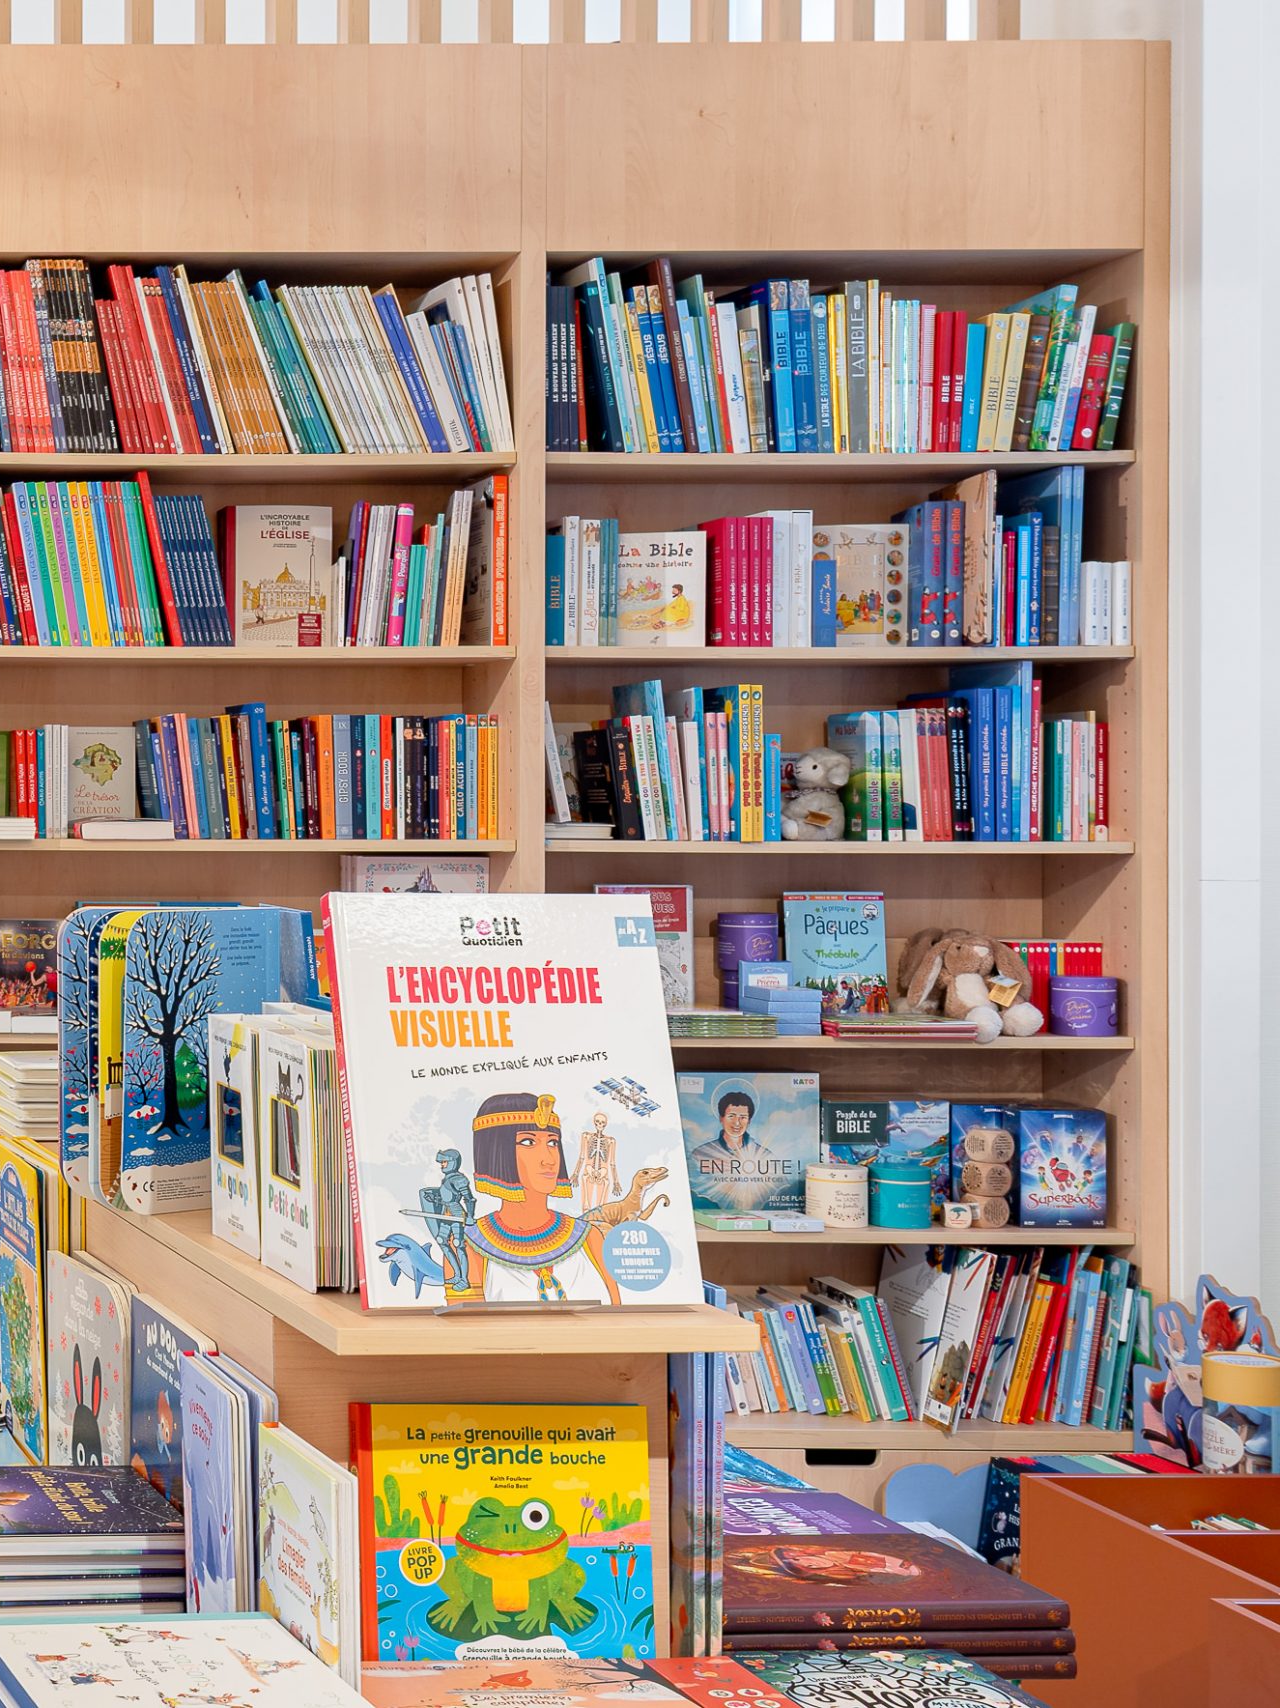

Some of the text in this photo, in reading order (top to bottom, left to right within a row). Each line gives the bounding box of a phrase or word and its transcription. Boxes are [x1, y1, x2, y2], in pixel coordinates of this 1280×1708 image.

[643, 333, 656, 364] JÉSUS
[656, 333, 669, 364] JÉSUS
[778, 331, 788, 369] BIBLE
[797, 331, 809, 374] BIBLE
[851, 312, 865, 378] LA BIBLE
[941, 375, 951, 402] BIBLE
[954, 374, 963, 402] BIBLE
[987, 376, 1001, 412] BIBLE
[1005, 376, 1019, 412] BIBLE
[261, 528, 310, 540] L'ÉGLISE
[931, 508, 941, 537] Bible
[950, 508, 960, 536] Bible
[619, 543, 694, 557] La Bible
[550, 575, 561, 609] BIBLE
[982, 752, 990, 773] BIBLE
[338, 751, 349, 803] GIPSY BOOK
[73, 805, 121, 815] CRÉATION
[871, 780, 879, 819] Ma Bible
[891, 780, 899, 819] Ma Bible
[459, 916, 522, 936] Petit
[804, 913, 869, 942] Pâques
[462, 936, 523, 947] Quotidien
[815, 949, 860, 960] Théobule
[386, 960, 603, 1004] L'ENCYCLOPÉDIE
[390, 1010, 514, 1048] VISUELLE
[411, 1051, 608, 1079] LE MONDE EXPLIQUÉ AUX ENFANTS
[836, 1119, 871, 1133] BIBLE
[339, 1069, 360, 1223] L'ENCYCLOPÉDIE VISUELLE
[700, 1160, 723, 1175] EN
[731, 1160, 792, 1175] ROUTE
[268, 1184, 309, 1229] Petit chat
[1028, 1193, 1102, 1211] SUPERBOOK
[621, 1230, 648, 1245] 280
[612, 1247, 661, 1256] INFOGRAPHIES
[621, 1257, 654, 1266] LUDIQUES
[146, 1321, 158, 1348] AU
[407, 1426, 617, 1445] La petite grenouille qui avait
[419, 1445, 607, 1471] une grande bouche
[407, 1555, 437, 1569] POP
[408, 1546, 433, 1556] LIVRE
[414, 1567, 434, 1580] UP
[466, 1646, 567, 1654] Découvrez le bébé de la célèbre
